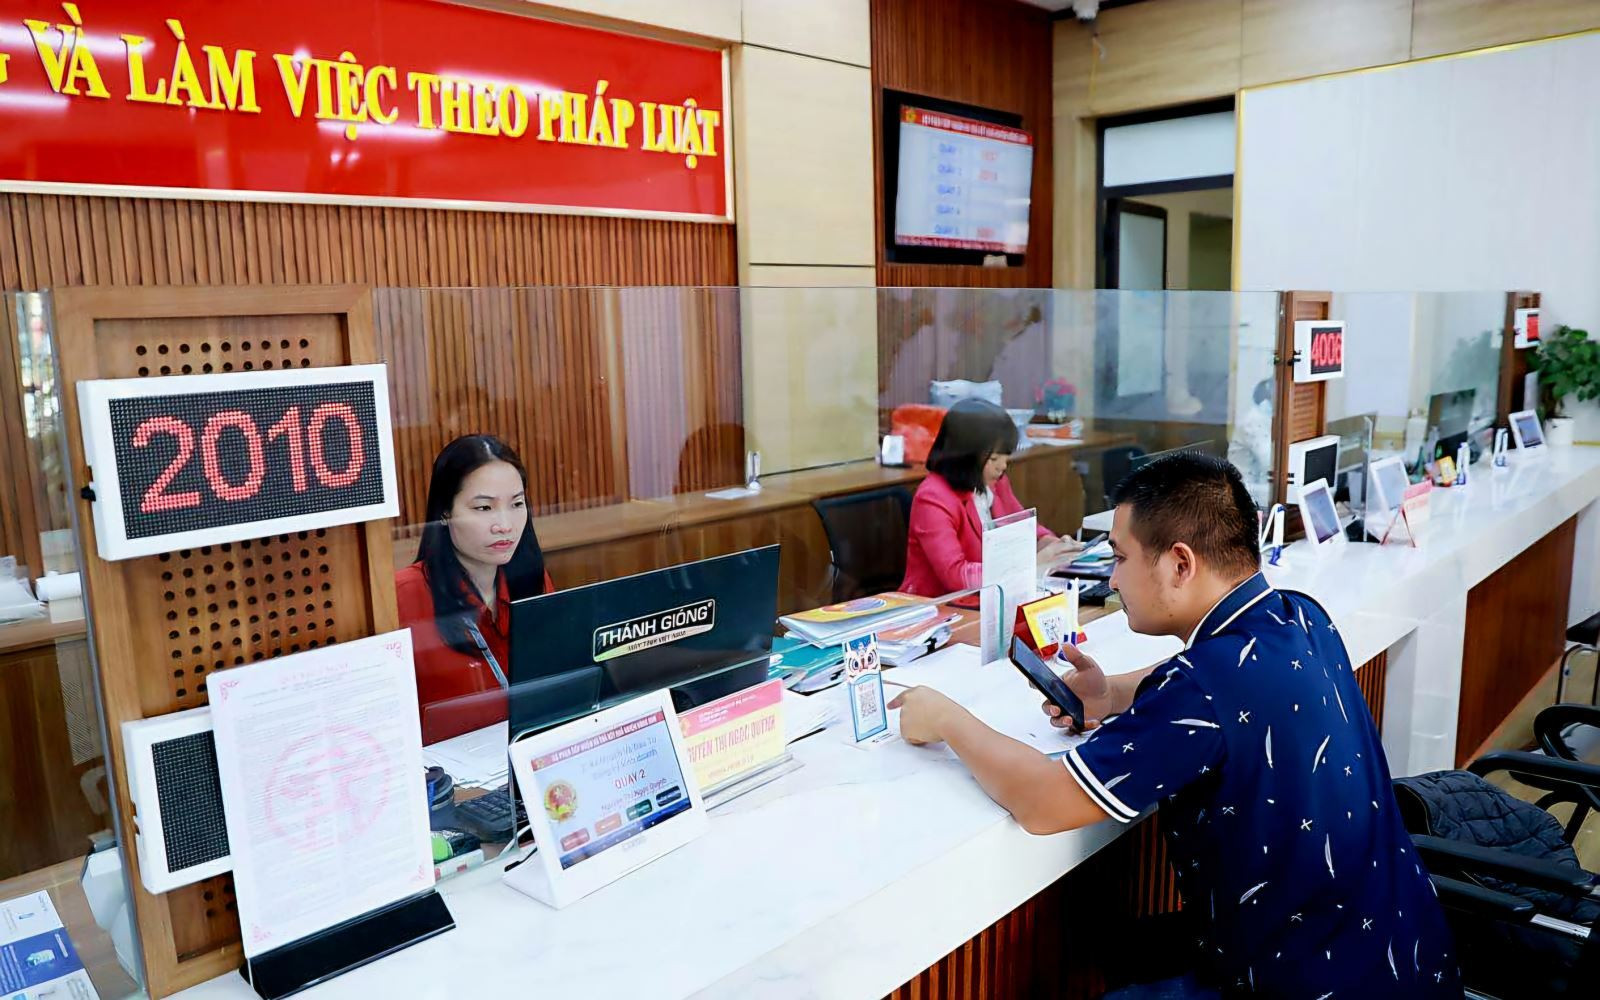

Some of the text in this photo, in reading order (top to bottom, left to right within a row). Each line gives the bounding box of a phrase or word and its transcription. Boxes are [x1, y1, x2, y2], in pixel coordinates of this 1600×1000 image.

[23, 2, 720, 168] VÀ LÀM VIỆC THEO PHÁP LUẬT
[132, 401, 366, 513] 2010
[599, 605, 708, 647] THÁNH GIÓNG
